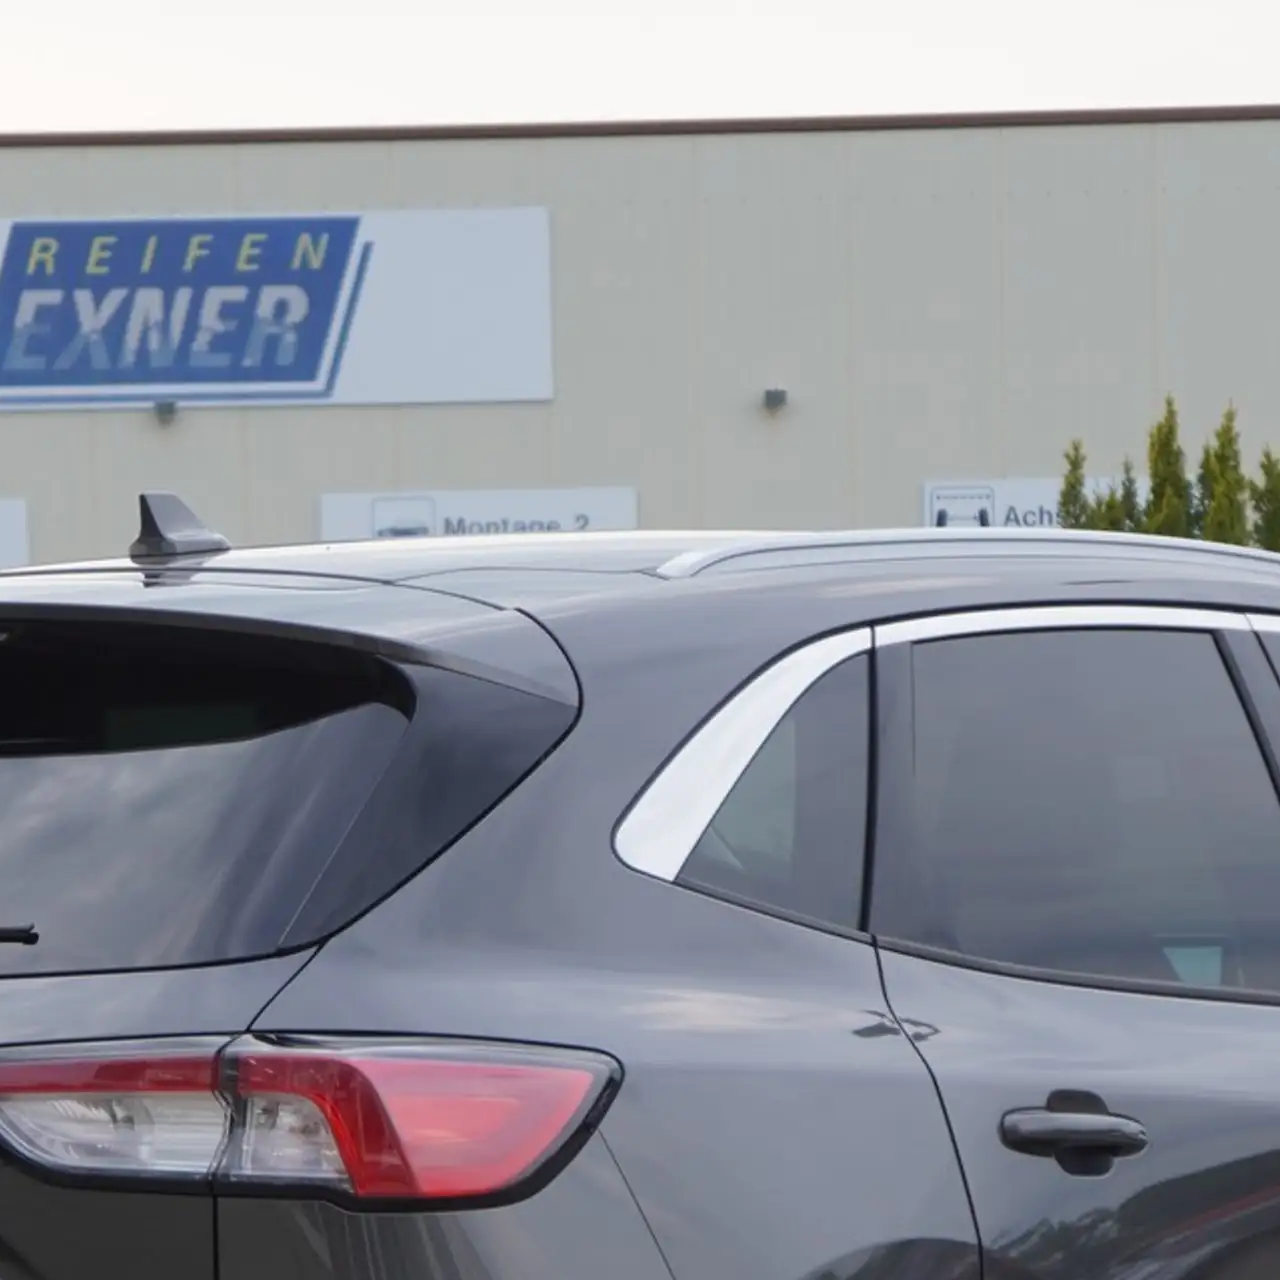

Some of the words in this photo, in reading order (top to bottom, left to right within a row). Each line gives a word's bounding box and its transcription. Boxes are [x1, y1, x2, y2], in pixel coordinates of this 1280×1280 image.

[26, 233, 330, 276] REIFEN
[2, 284, 310, 372] EXNER
[1003, 504, 1064, 527] Ach
